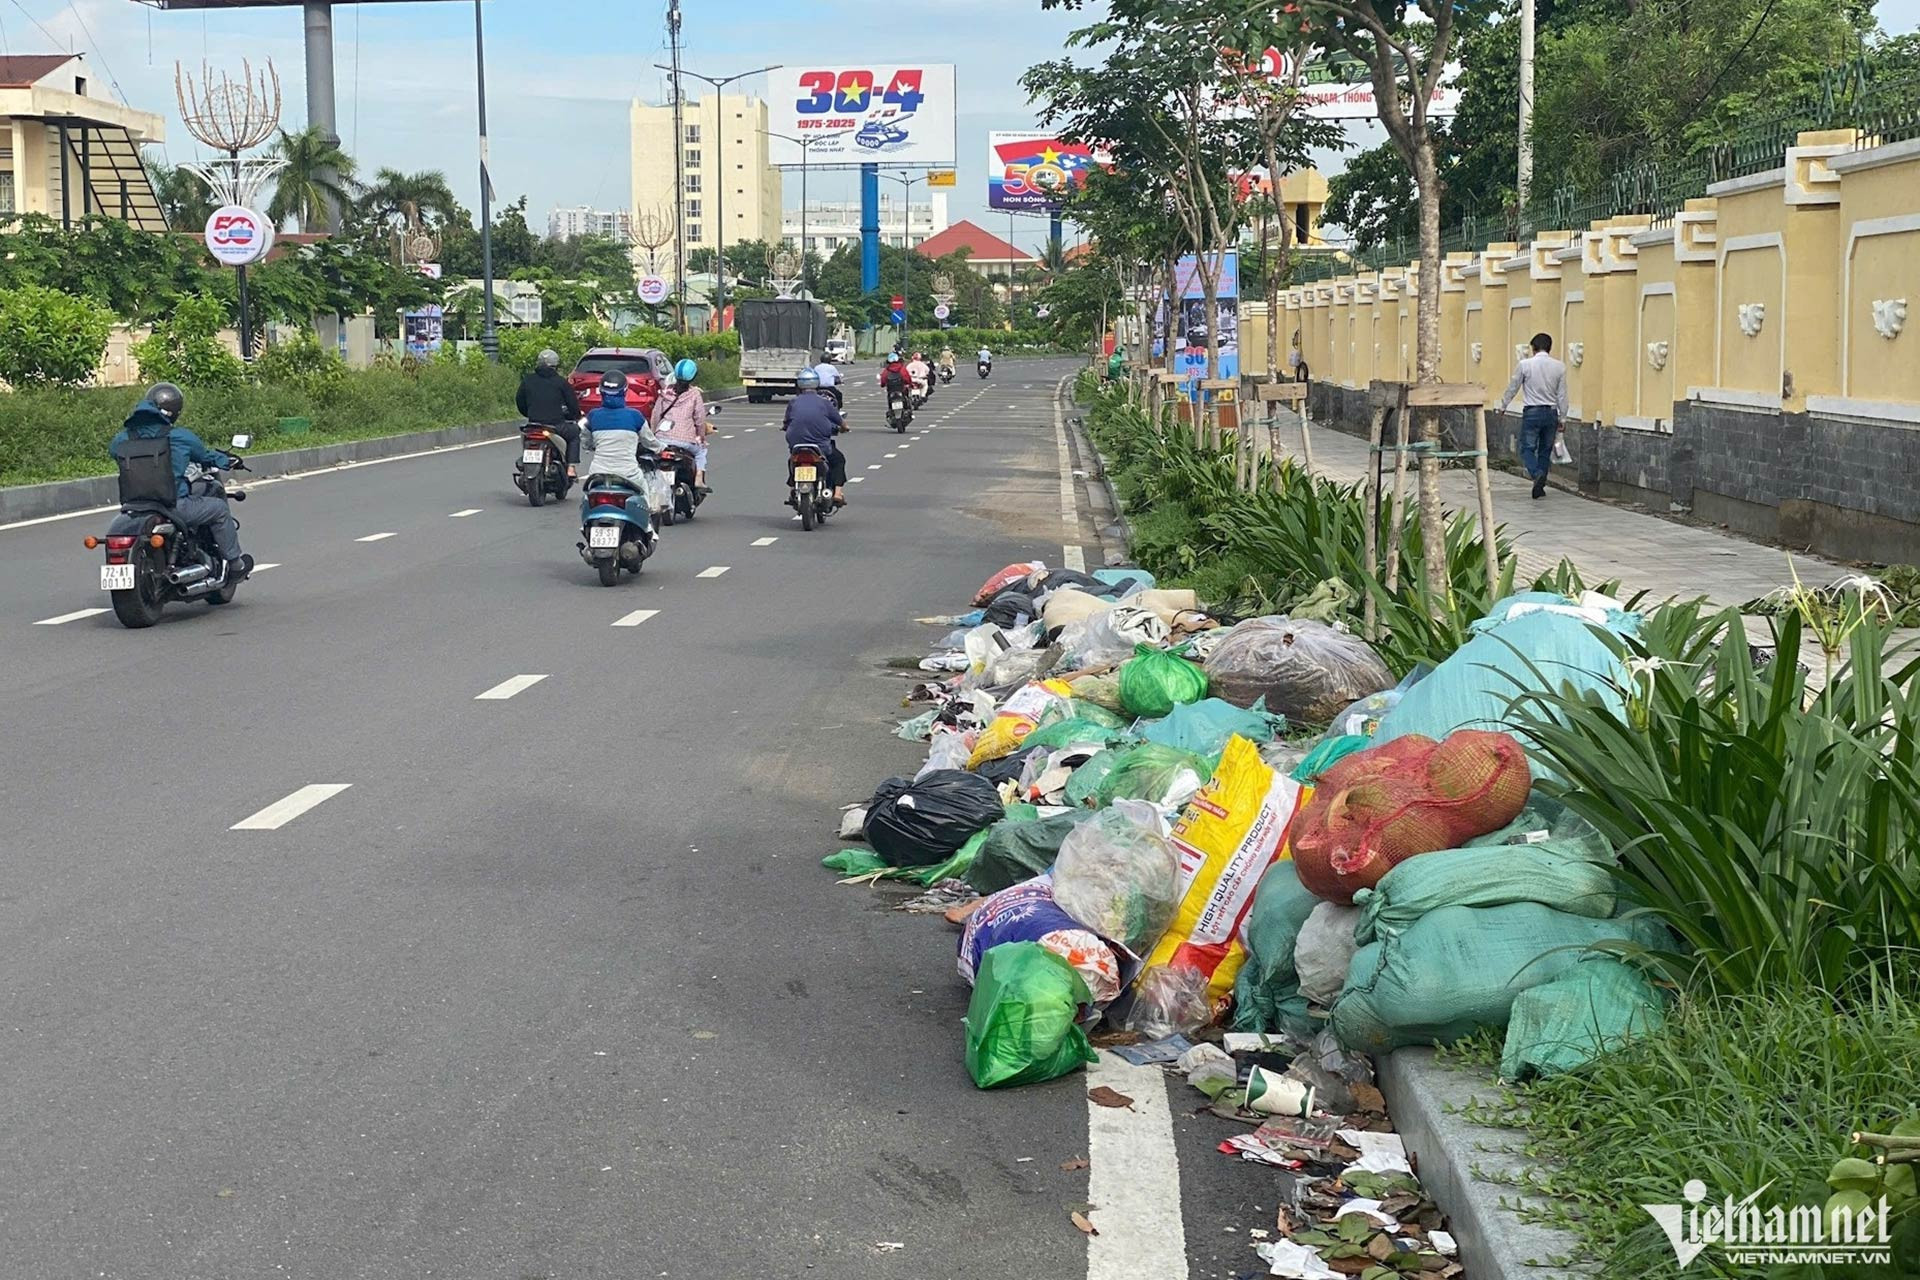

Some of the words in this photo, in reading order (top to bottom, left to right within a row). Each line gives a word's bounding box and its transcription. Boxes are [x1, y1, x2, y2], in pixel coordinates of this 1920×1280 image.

[796, 70, 924, 113] 30-4
[213, 216, 255, 245] 50
[1198, 902, 1217, 933] HIGH
[1214, 854, 1244, 902] QUALITY
[1242, 803, 1271, 853] PRODUCT
